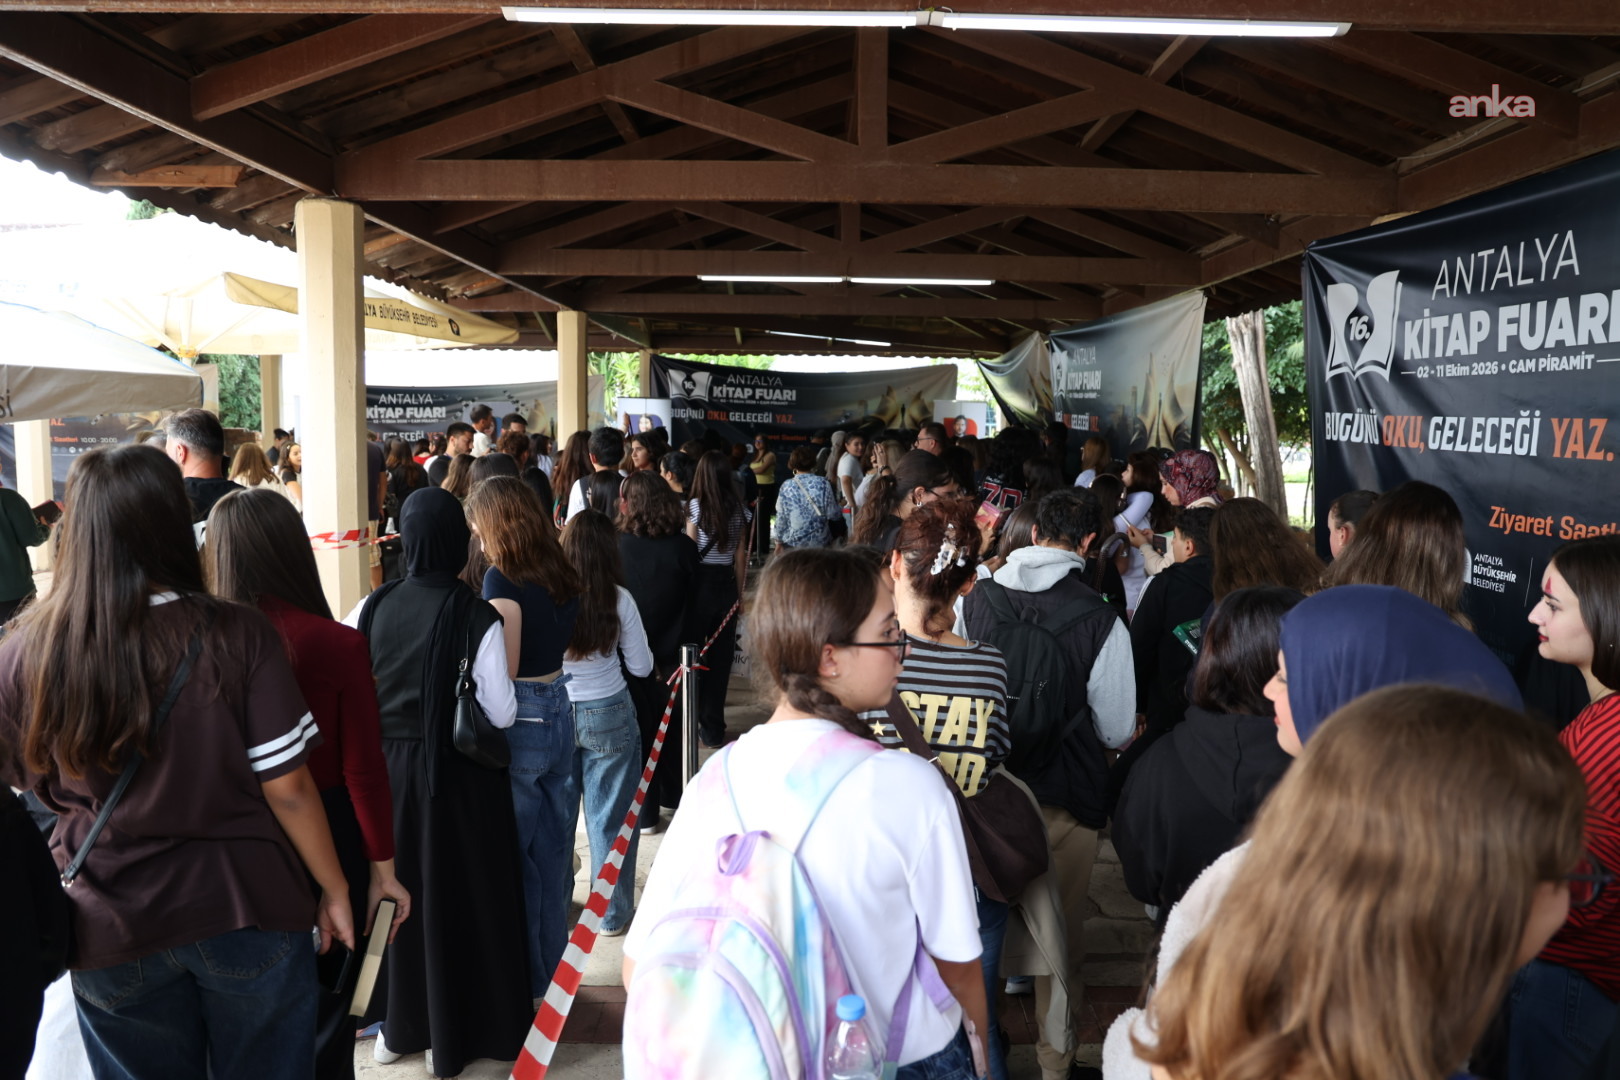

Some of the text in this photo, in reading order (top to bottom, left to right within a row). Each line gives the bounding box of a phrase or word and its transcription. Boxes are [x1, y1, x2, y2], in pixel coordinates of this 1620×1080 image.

[1431, 230, 1580, 300] ANTALYA
[1349, 315, 1371, 341] 16.
[1403, 308, 1491, 360] KİTAP
[1416, 366, 1429, 378] 02
[1436, 365, 1444, 378] 11
[1445, 363, 1470, 377] Ekim
[1471, 361, 1499, 376] 2026
[1508, 358, 1536, 374] CAM
[1538, 351, 1595, 372] PİRAMİT
[726, 374, 783, 387] ANTALYA
[378, 393, 433, 404] ANTALYA
[712, 384, 797, 401] KİTAP FUARI
[366, 404, 446, 419] KİTAP FUARI
[729, 411, 772, 424] GELECEĞİ
[1325, 407, 1615, 462] BUGÜNÜ OKU, GELECEĞİ YAZ.
[1489, 505, 1554, 537] Ziyaret
[1474, 553, 1504, 567] ANTALYA
[1473, 564, 1517, 583] BÜYÜKŞEHİR
[1472, 577, 1506, 593] BELEDİYESİ
